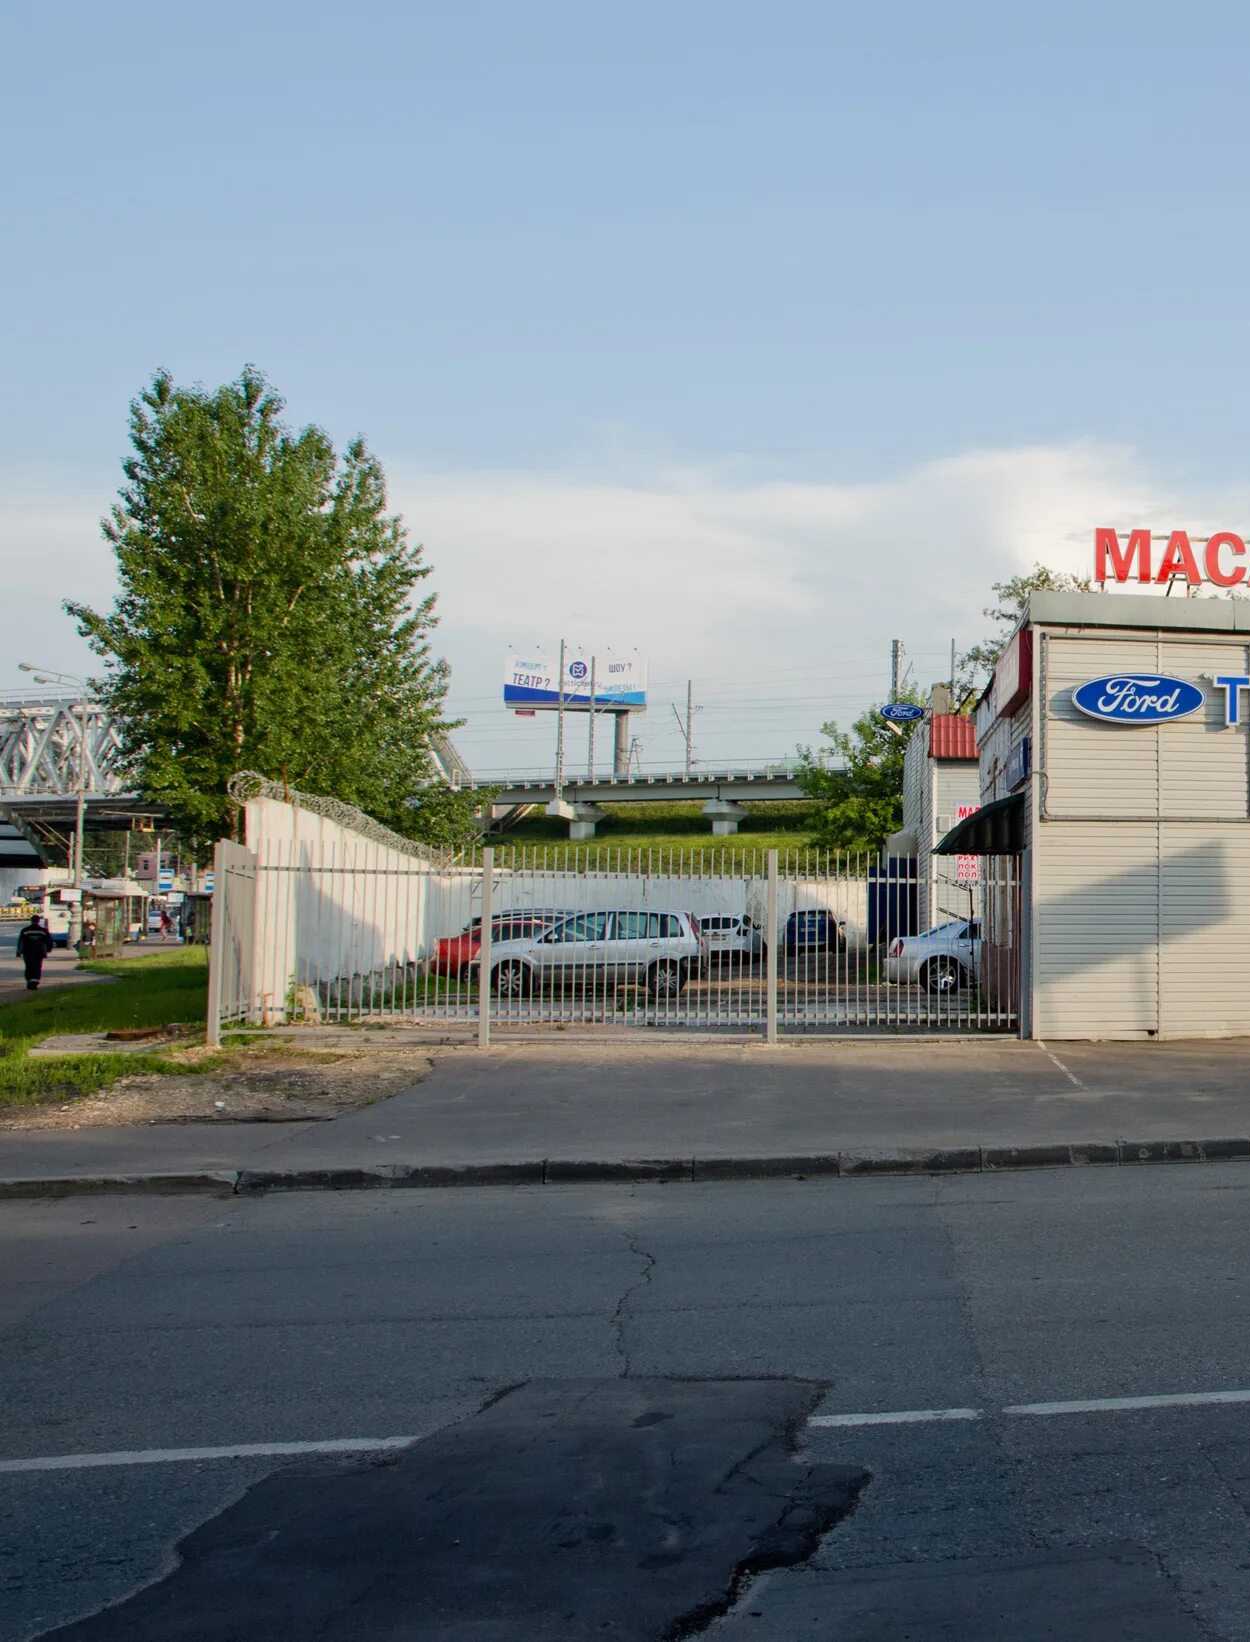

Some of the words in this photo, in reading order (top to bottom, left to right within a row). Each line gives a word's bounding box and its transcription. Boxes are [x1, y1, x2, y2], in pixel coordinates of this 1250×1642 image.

[608, 663, 625, 674] ШОУ
[513, 672, 543, 688] ТЕАТР
[544, 678, 551, 690] ?
[1098, 678, 1181, 713] Ford
[890, 706, 914, 717] Ford
